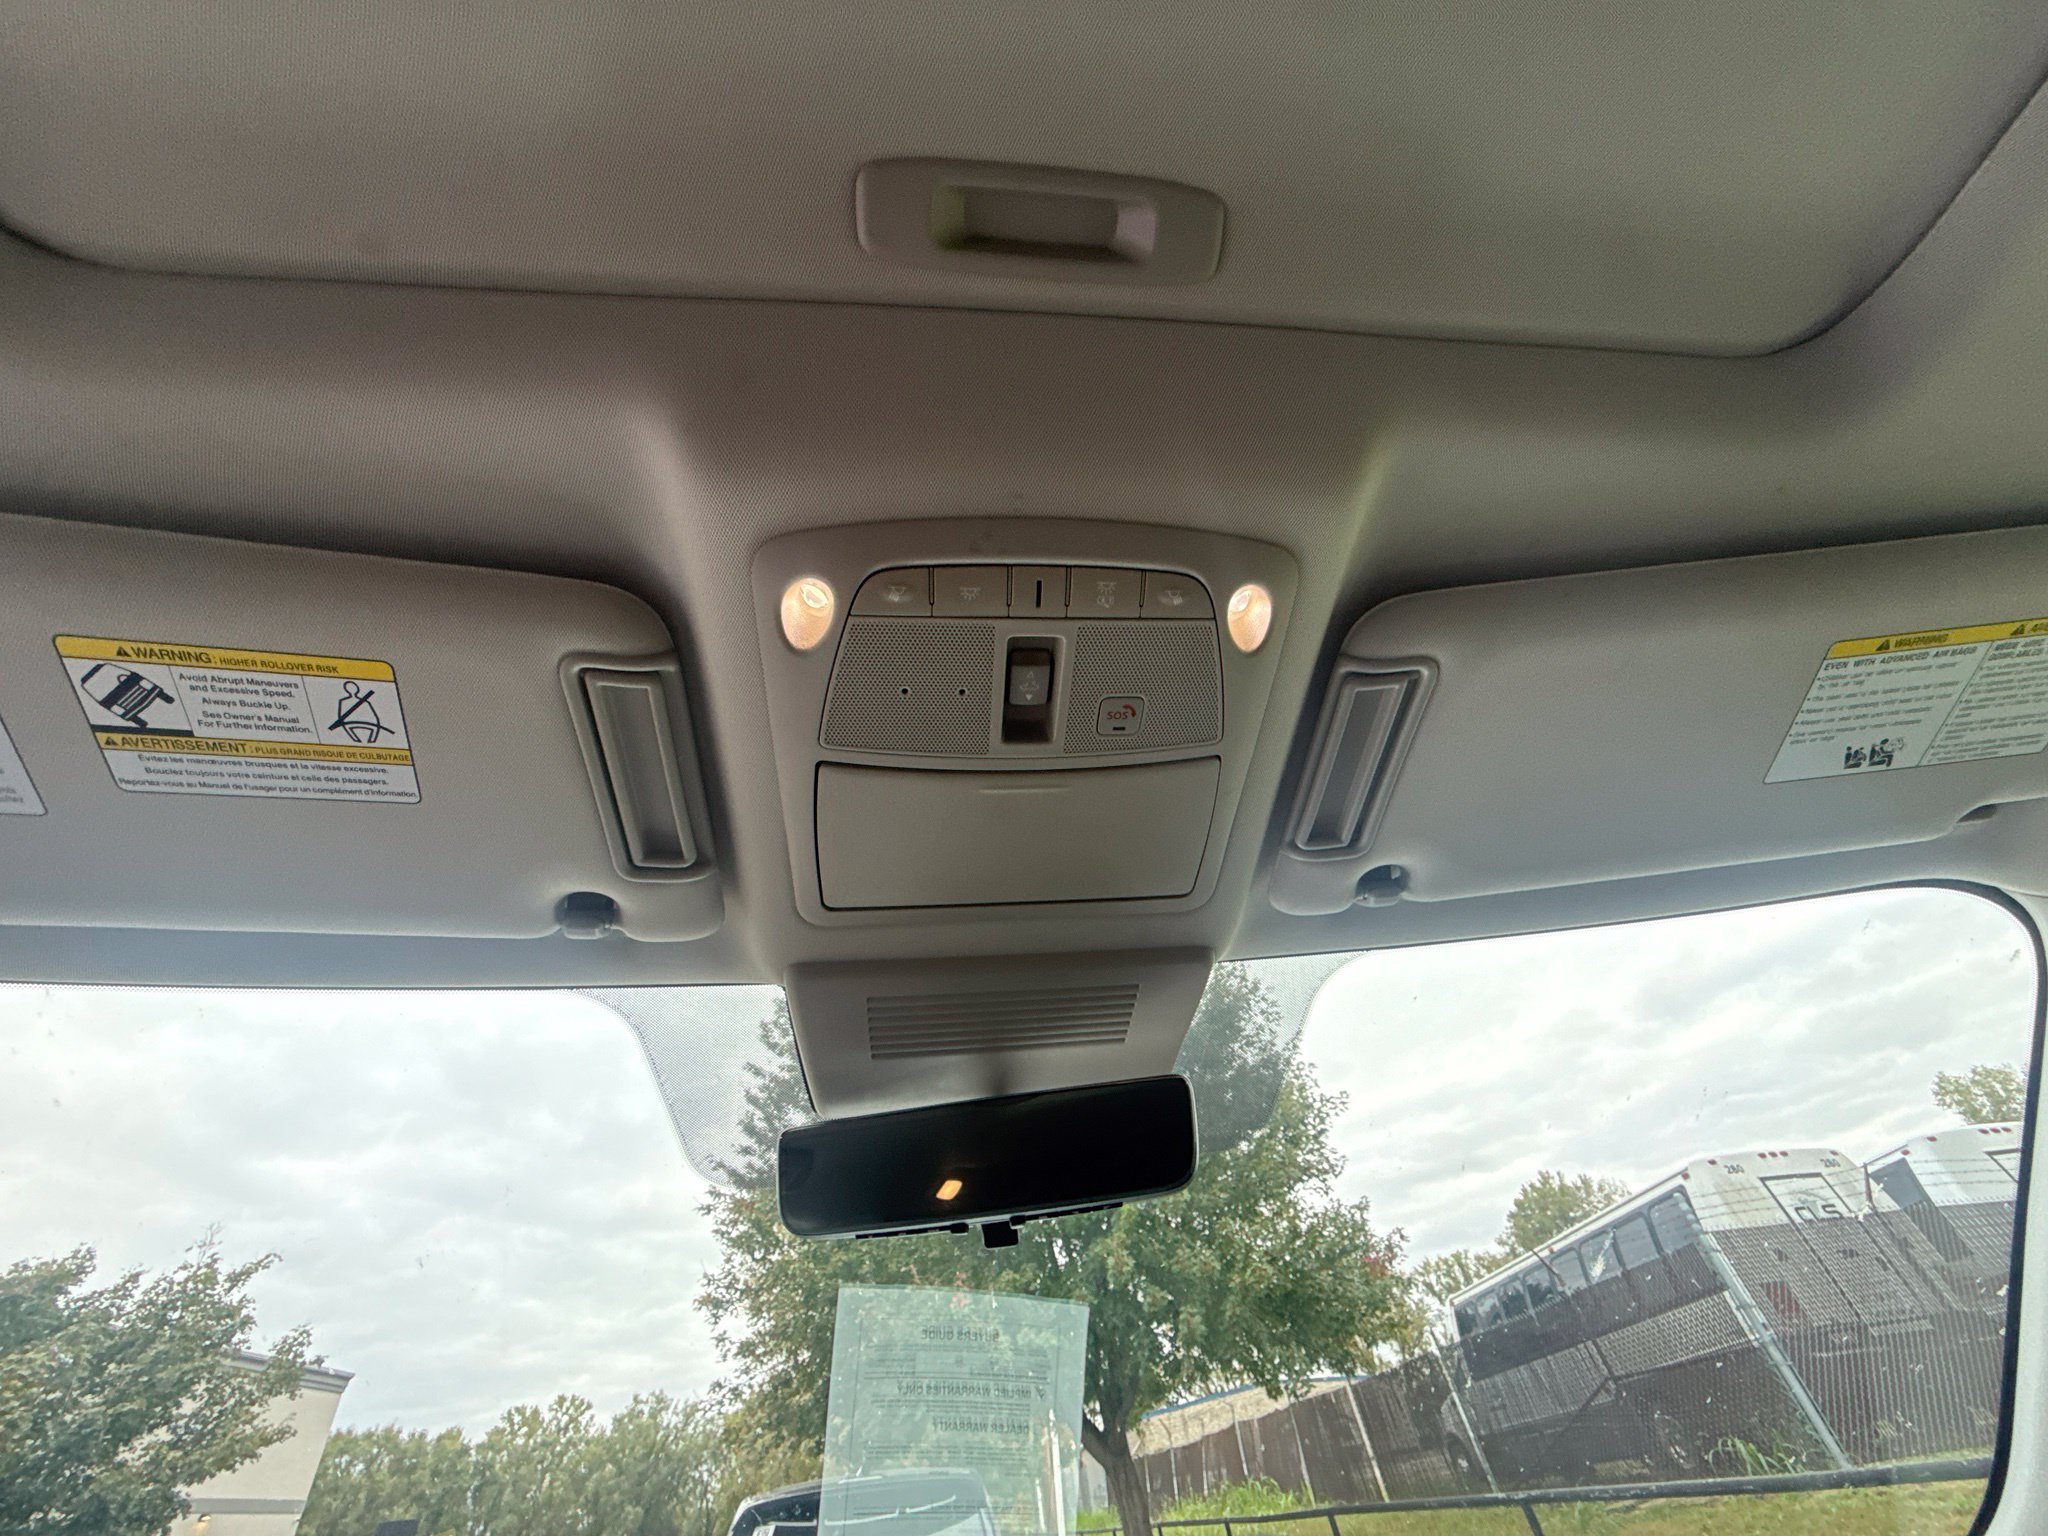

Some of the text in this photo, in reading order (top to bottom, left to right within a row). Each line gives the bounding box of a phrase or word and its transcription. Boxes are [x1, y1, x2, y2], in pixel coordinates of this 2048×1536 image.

[220, 657, 257, 668] HIGHER
[261, 660, 315, 672] ROLLOVER
[316, 664, 339, 674] RISK
[1824, 661, 1850, 671] EVEN
[1853, 658, 1876, 668] WITH
[1879, 652, 1930, 664] ADVANCED
[180, 673, 299, 689] Avoid Abrupt Maneuvers
[189, 684, 295, 698] and Excessive Speed.
[202, 697, 291, 711] Always Buckle Up.
[202, 710, 299, 724] See Owner's Manual
[1106, 711, 1128, 720] SOS
[197, 719, 214, 727] For
[216, 720, 252, 730] Further
[121, 736, 247, 754] AVERTISSEMENT
[255, 746, 279, 755] PLUS
[280, 748, 311, 757] GRAND
[312, 749, 344, 759] RISQUE
[346, 751, 357, 759] DE
[358, 752, 410, 762] CULBUTAGE
[245, 760, 288, 769] brusques
[311, 763, 341, 771] vitesse
[344, 766, 389, 774] excessive.
[144, 766, 183, 775] Bouclez
[184, 769, 225, 777] toujours
[252, 772, 289, 780] ceinture
[342, 777, 389, 786] passagers.
[198, 781, 230, 789] Manuel
